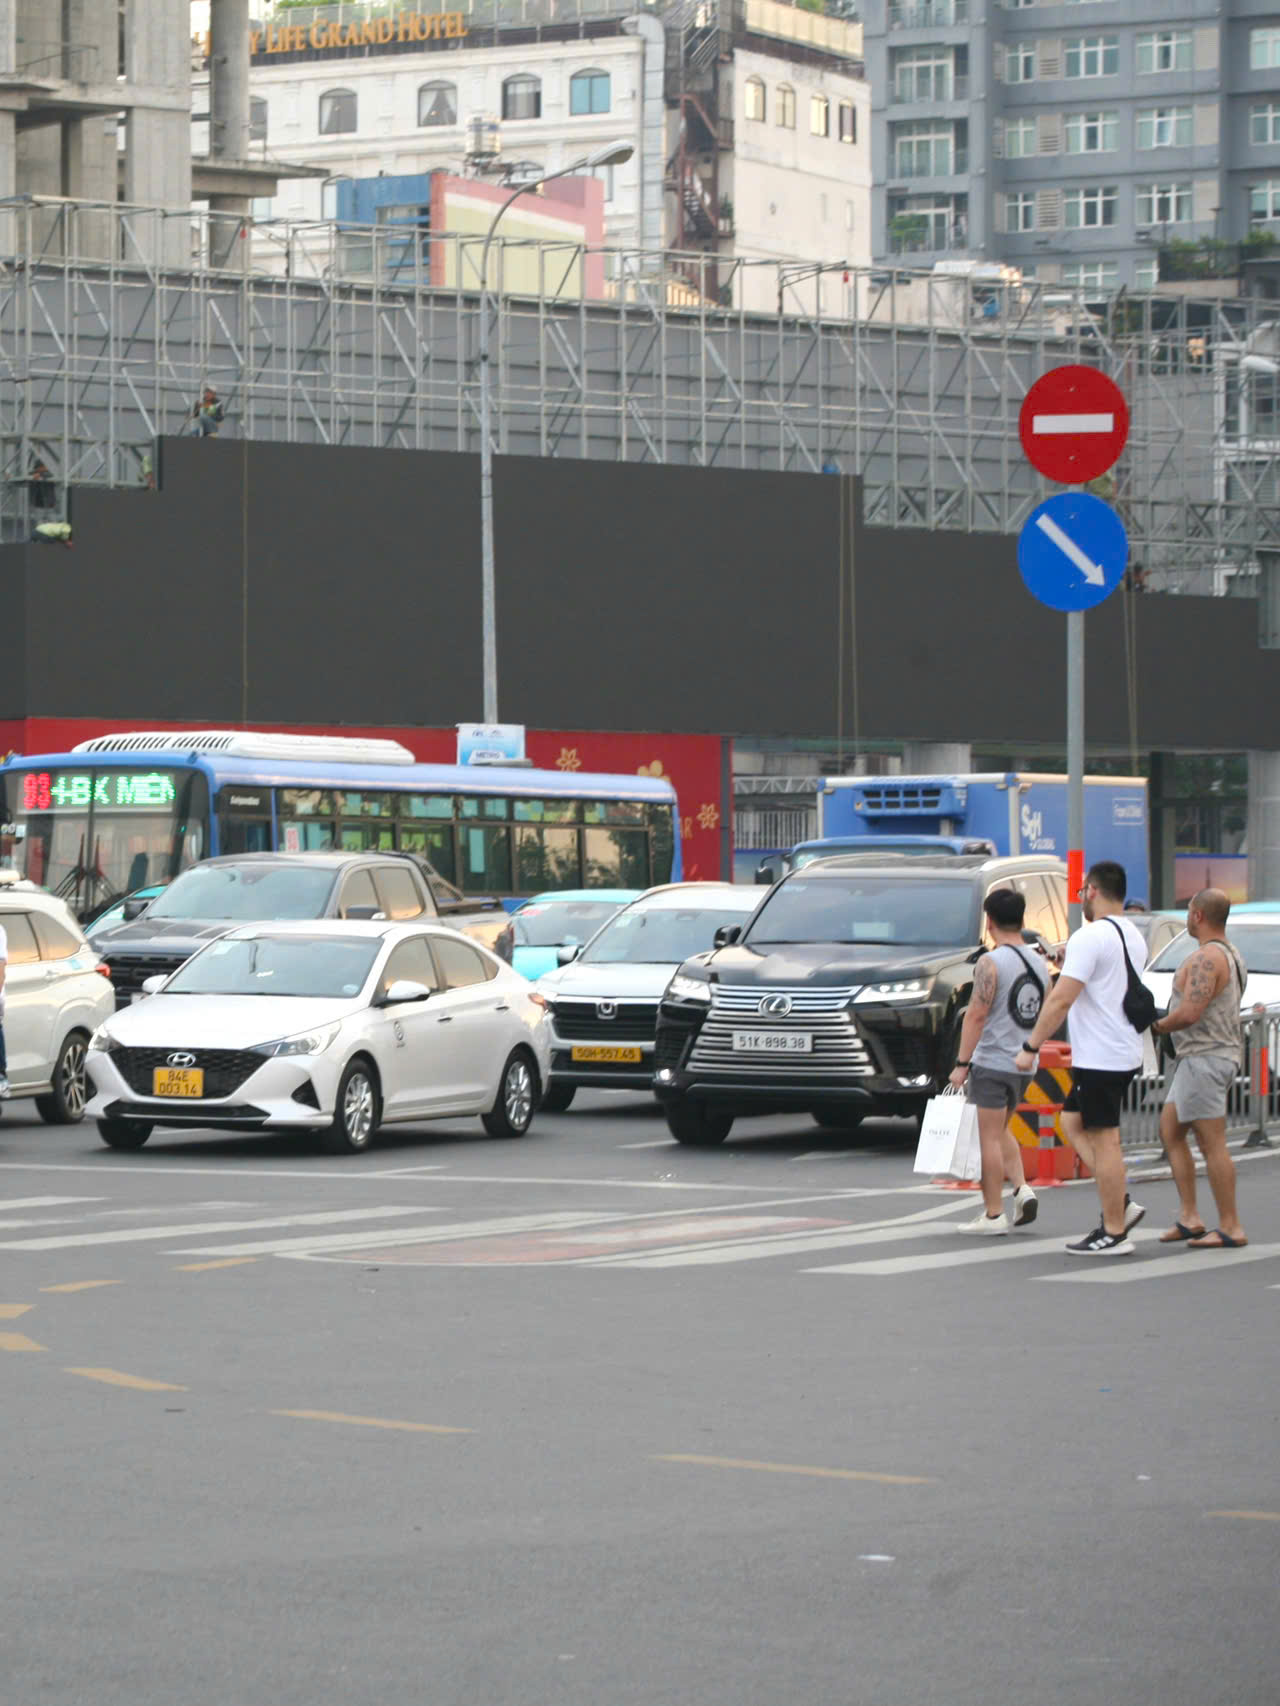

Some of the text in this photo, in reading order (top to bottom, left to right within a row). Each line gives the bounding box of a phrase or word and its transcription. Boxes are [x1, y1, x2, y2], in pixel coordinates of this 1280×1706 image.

[266, 23, 305, 54] LIFE
[310, 17, 395, 48] GRAND
[397, 11, 468, 42] HOTEL
